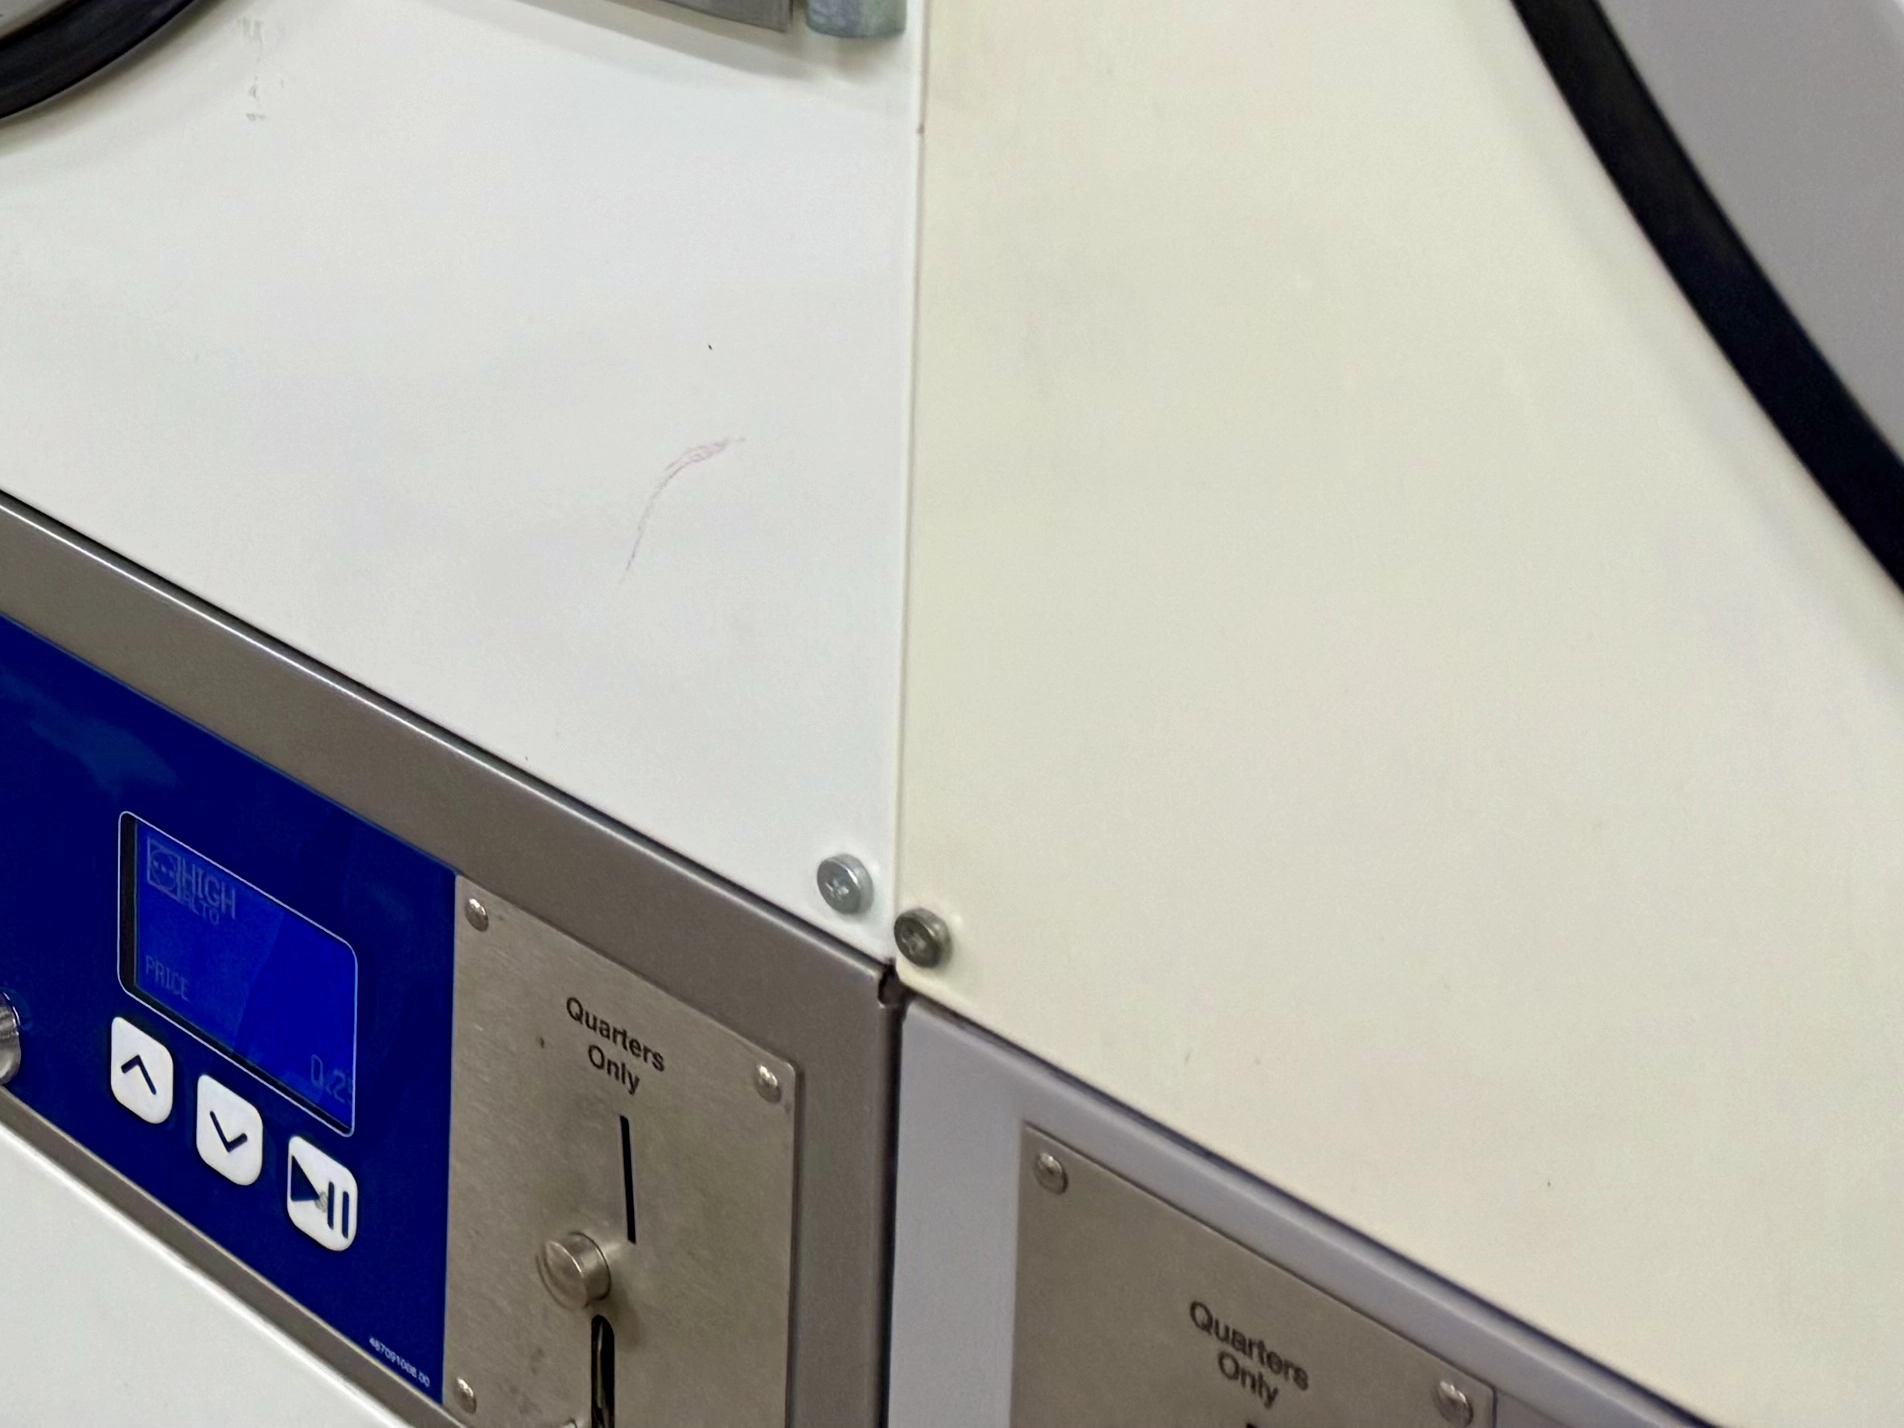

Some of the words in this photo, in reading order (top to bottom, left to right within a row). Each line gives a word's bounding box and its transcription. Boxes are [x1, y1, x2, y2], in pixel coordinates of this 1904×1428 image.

[181, 857, 237, 921] HIGH
[144, 954, 191, 1003] PRICE
[566, 995, 666, 1073] Quarters
[587, 1043, 641, 1097] Only
[1189, 1299, 1310, 1393] Quarters
[1217, 1349, 1280, 1411] Only
